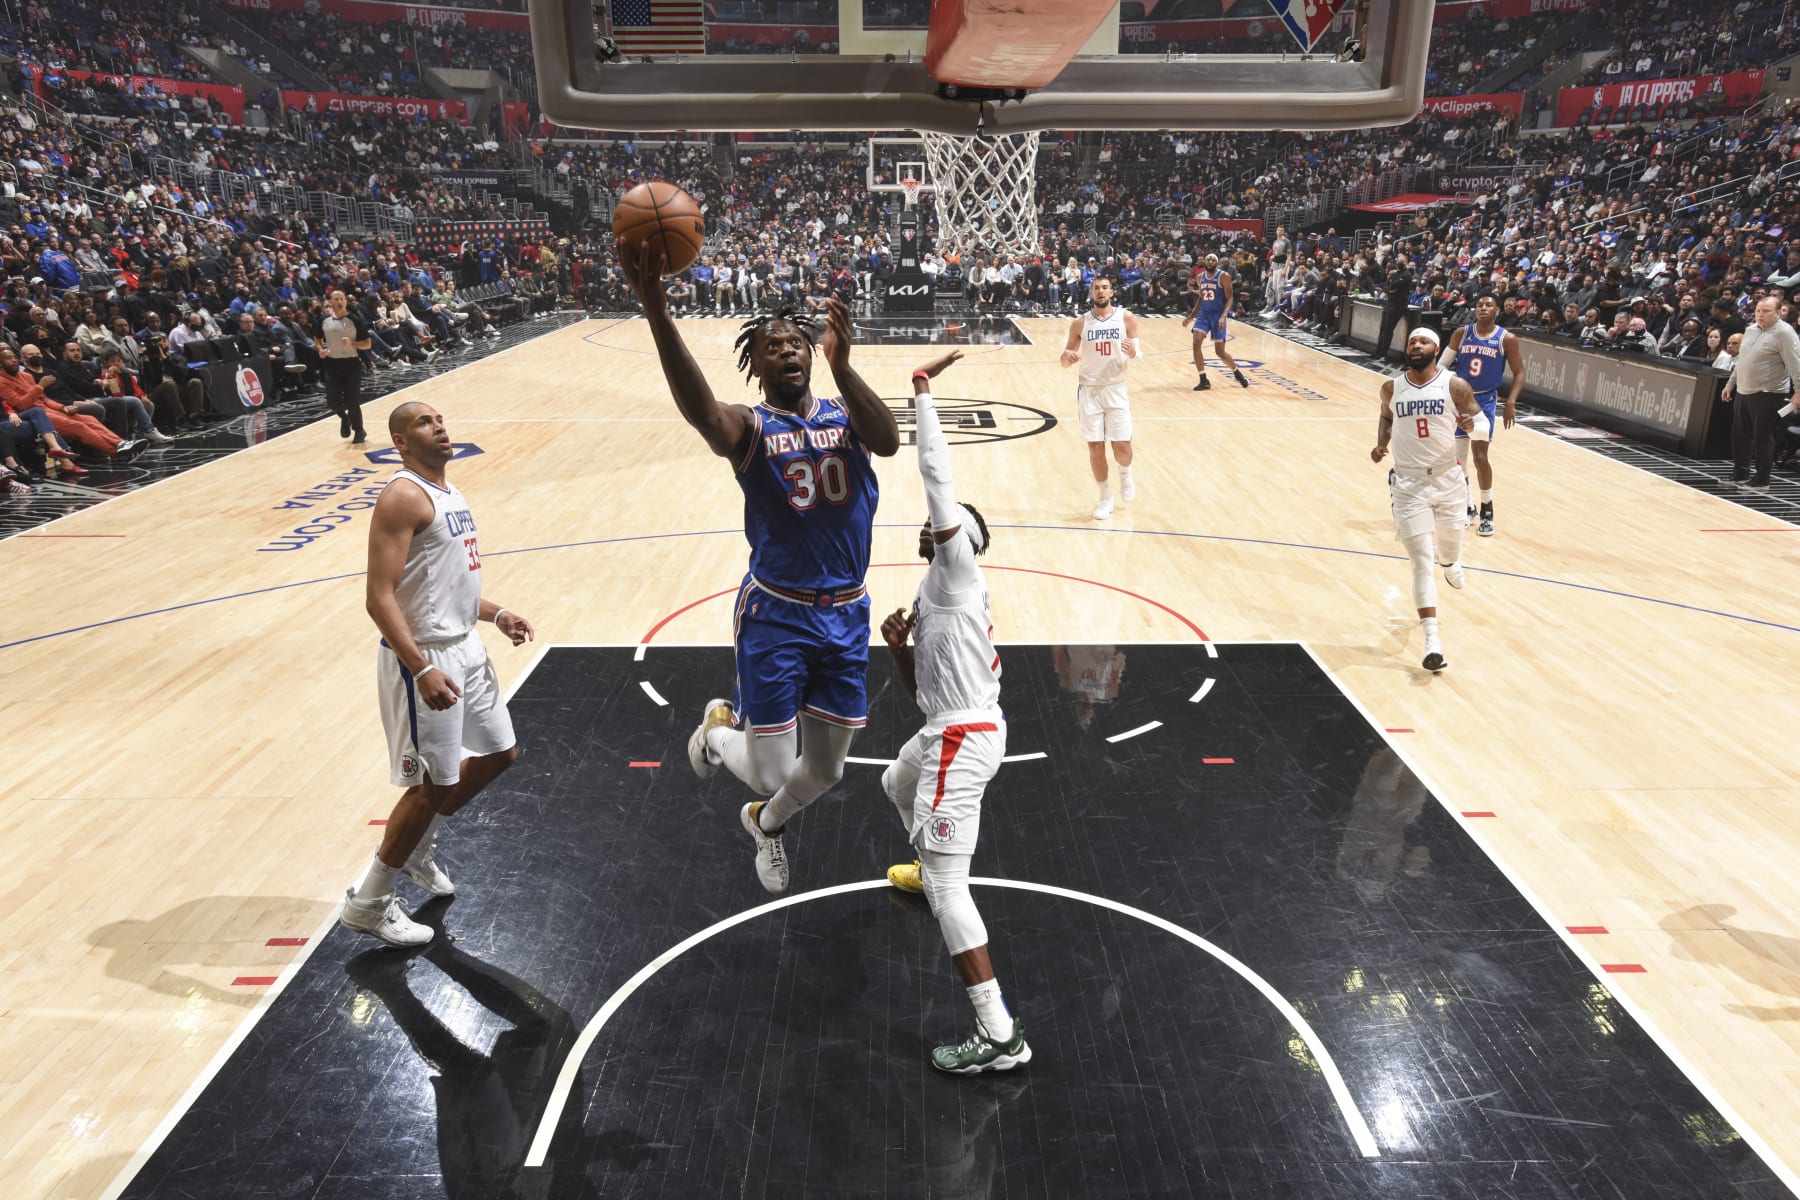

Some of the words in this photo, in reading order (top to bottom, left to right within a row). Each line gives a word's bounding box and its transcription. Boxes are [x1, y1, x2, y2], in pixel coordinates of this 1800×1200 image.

[1634, 79, 1696, 106] CLIPPERS
[465, 177, 498, 185] EXPRESS
[1203, 290, 1215, 301] 23
[1087, 328, 1120, 341] CLIPPERS
[1095, 341, 1111, 356] 40
[1461, 344, 1477, 355] NEW
[1477, 345, 1498, 359] YORK
[1469, 358, 1482, 377] 9
[1594, 371, 1634, 413] Noches
[1395, 399, 1445, 418] CLIPPERS
[1416, 418, 1430, 438] 8
[764, 430, 805, 456] NEW
[808, 426, 853, 449] YORK
[271, 467, 380, 510] ARENA
[783, 453, 851, 510] 30
[464, 537, 481, 571] 33
